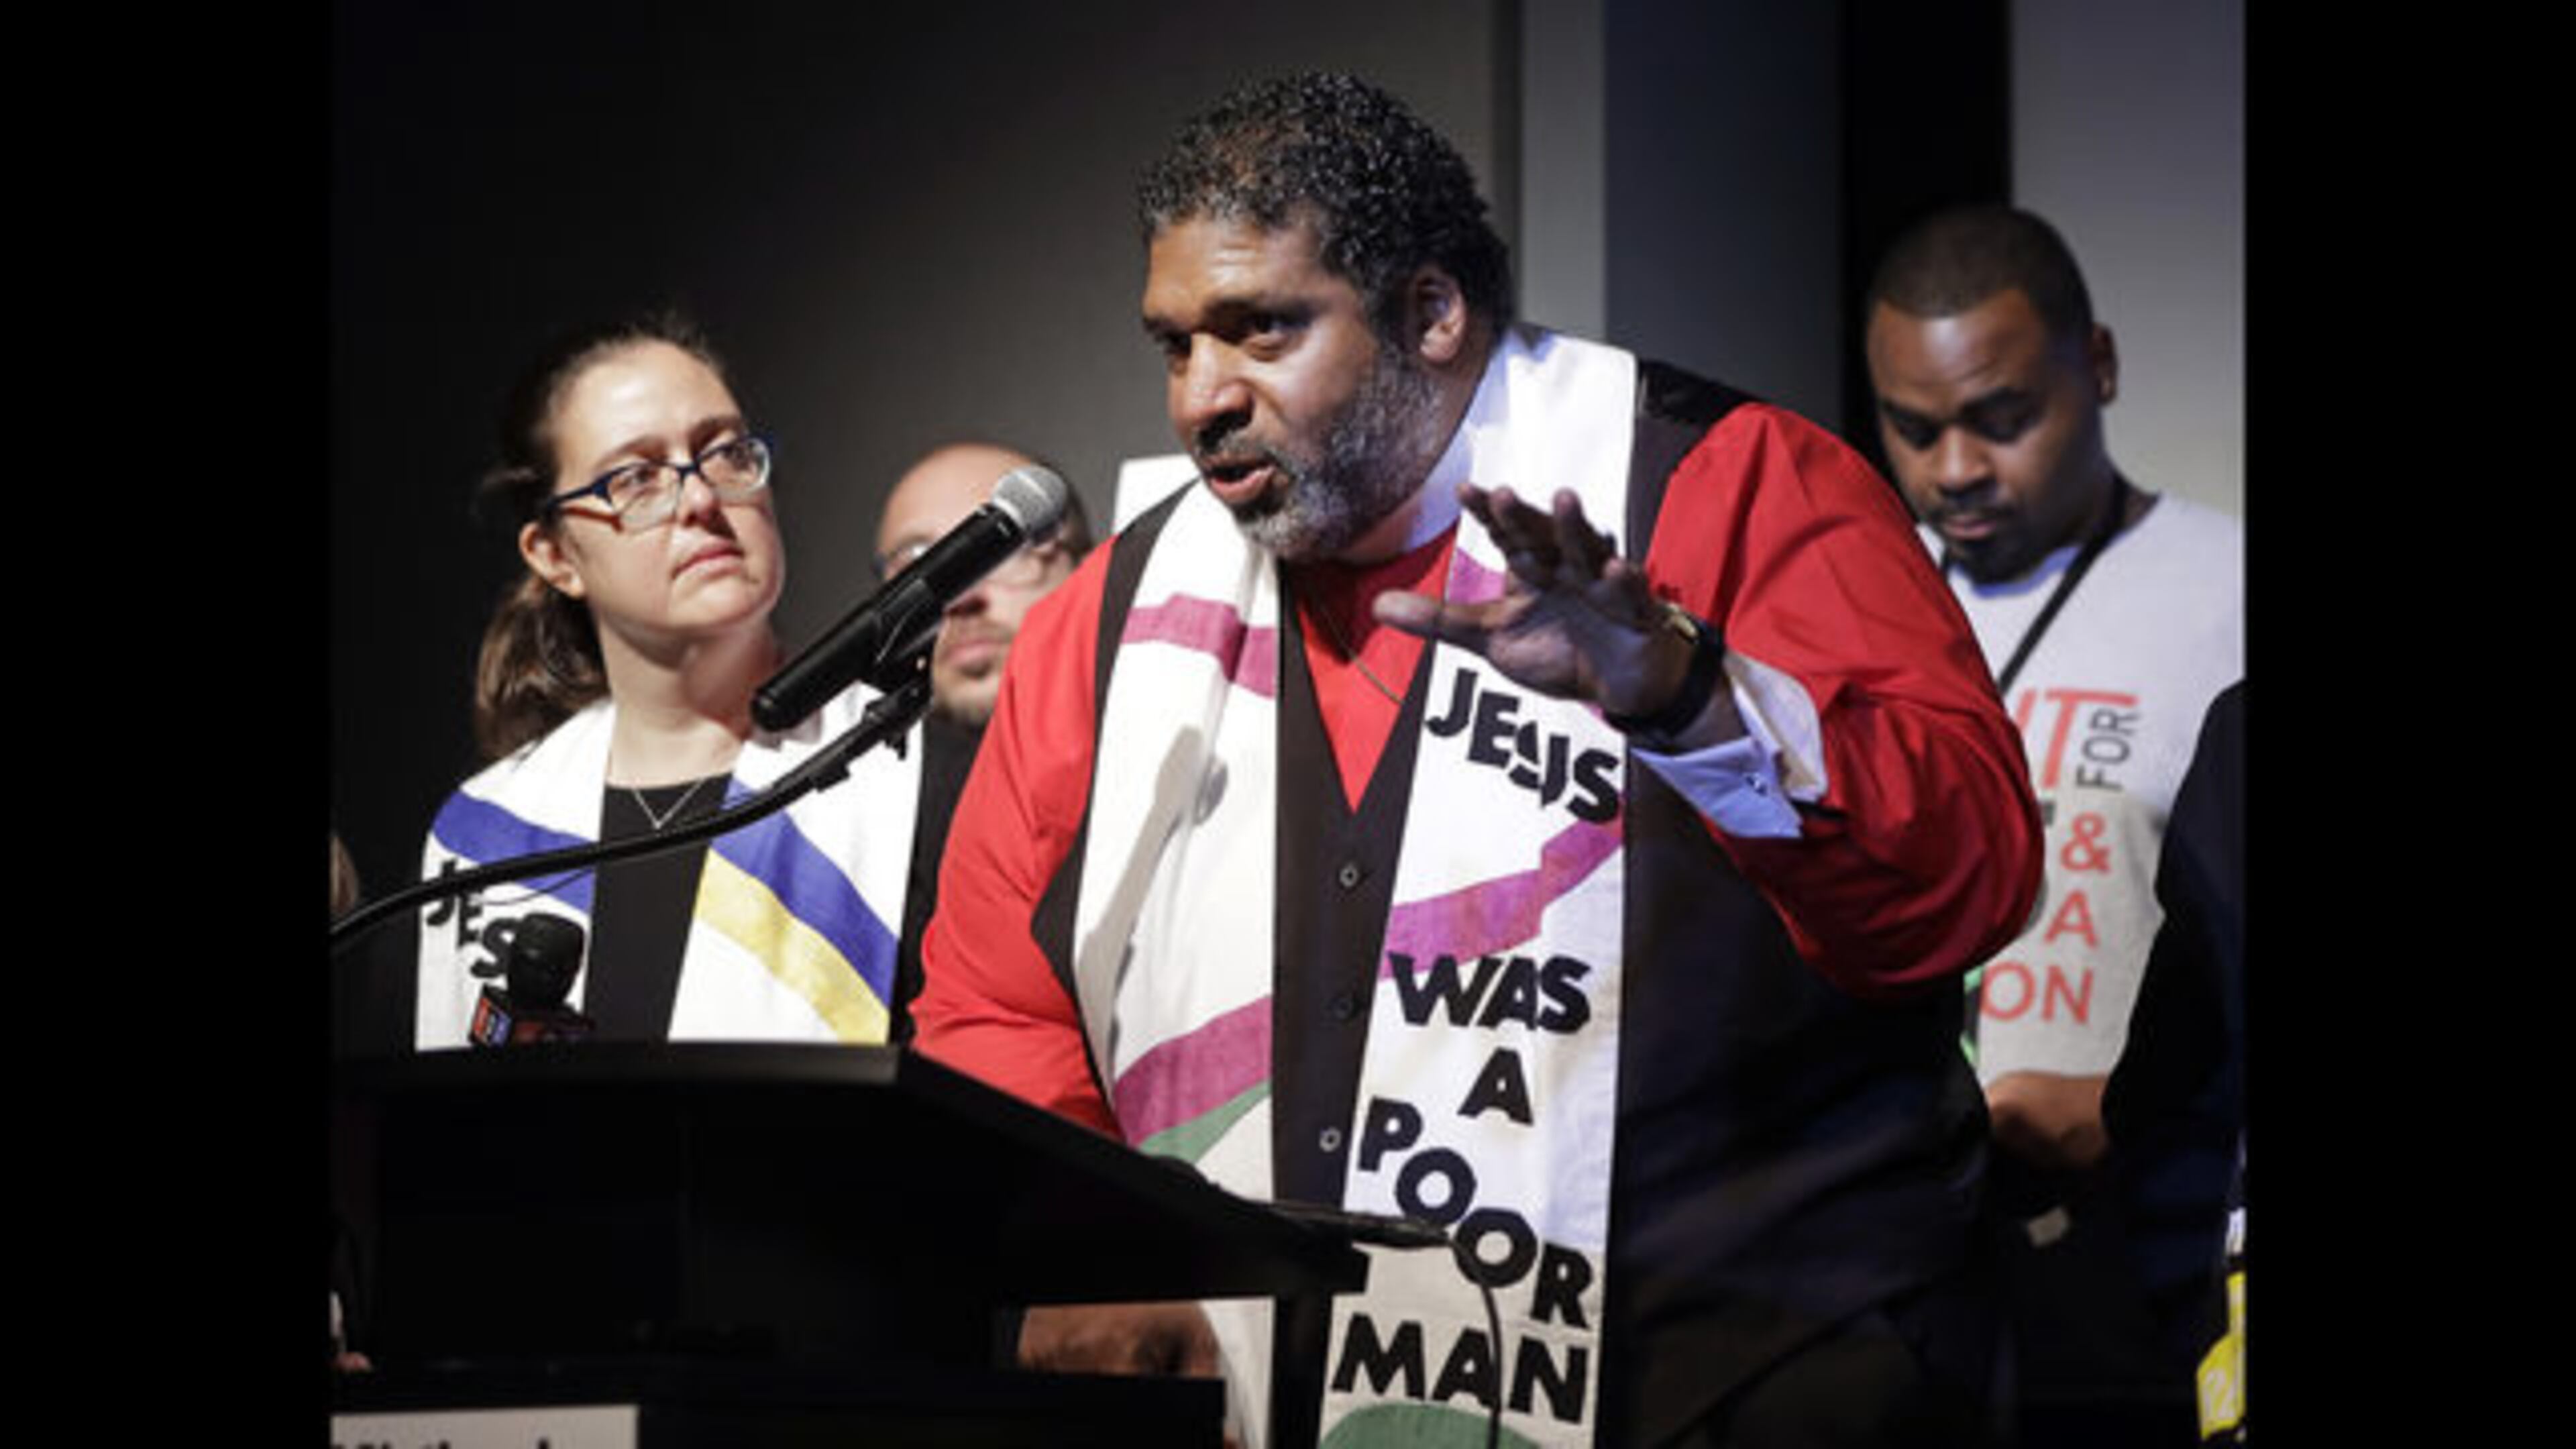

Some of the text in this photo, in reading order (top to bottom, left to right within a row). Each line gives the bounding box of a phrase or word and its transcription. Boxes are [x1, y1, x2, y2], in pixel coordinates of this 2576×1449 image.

[2076, 708, 2140, 792] FOR
[2059, 812, 2110, 874] &
[425, 859, 518, 979] JES
[2042, 890, 2098, 950] A
[1388, 951, 1591, 1034] WAS
[1457, 1047, 1534, 1128] A
[1357, 1096, 1593, 1330] POOR
[1331, 1312, 1589, 1425] MAN
